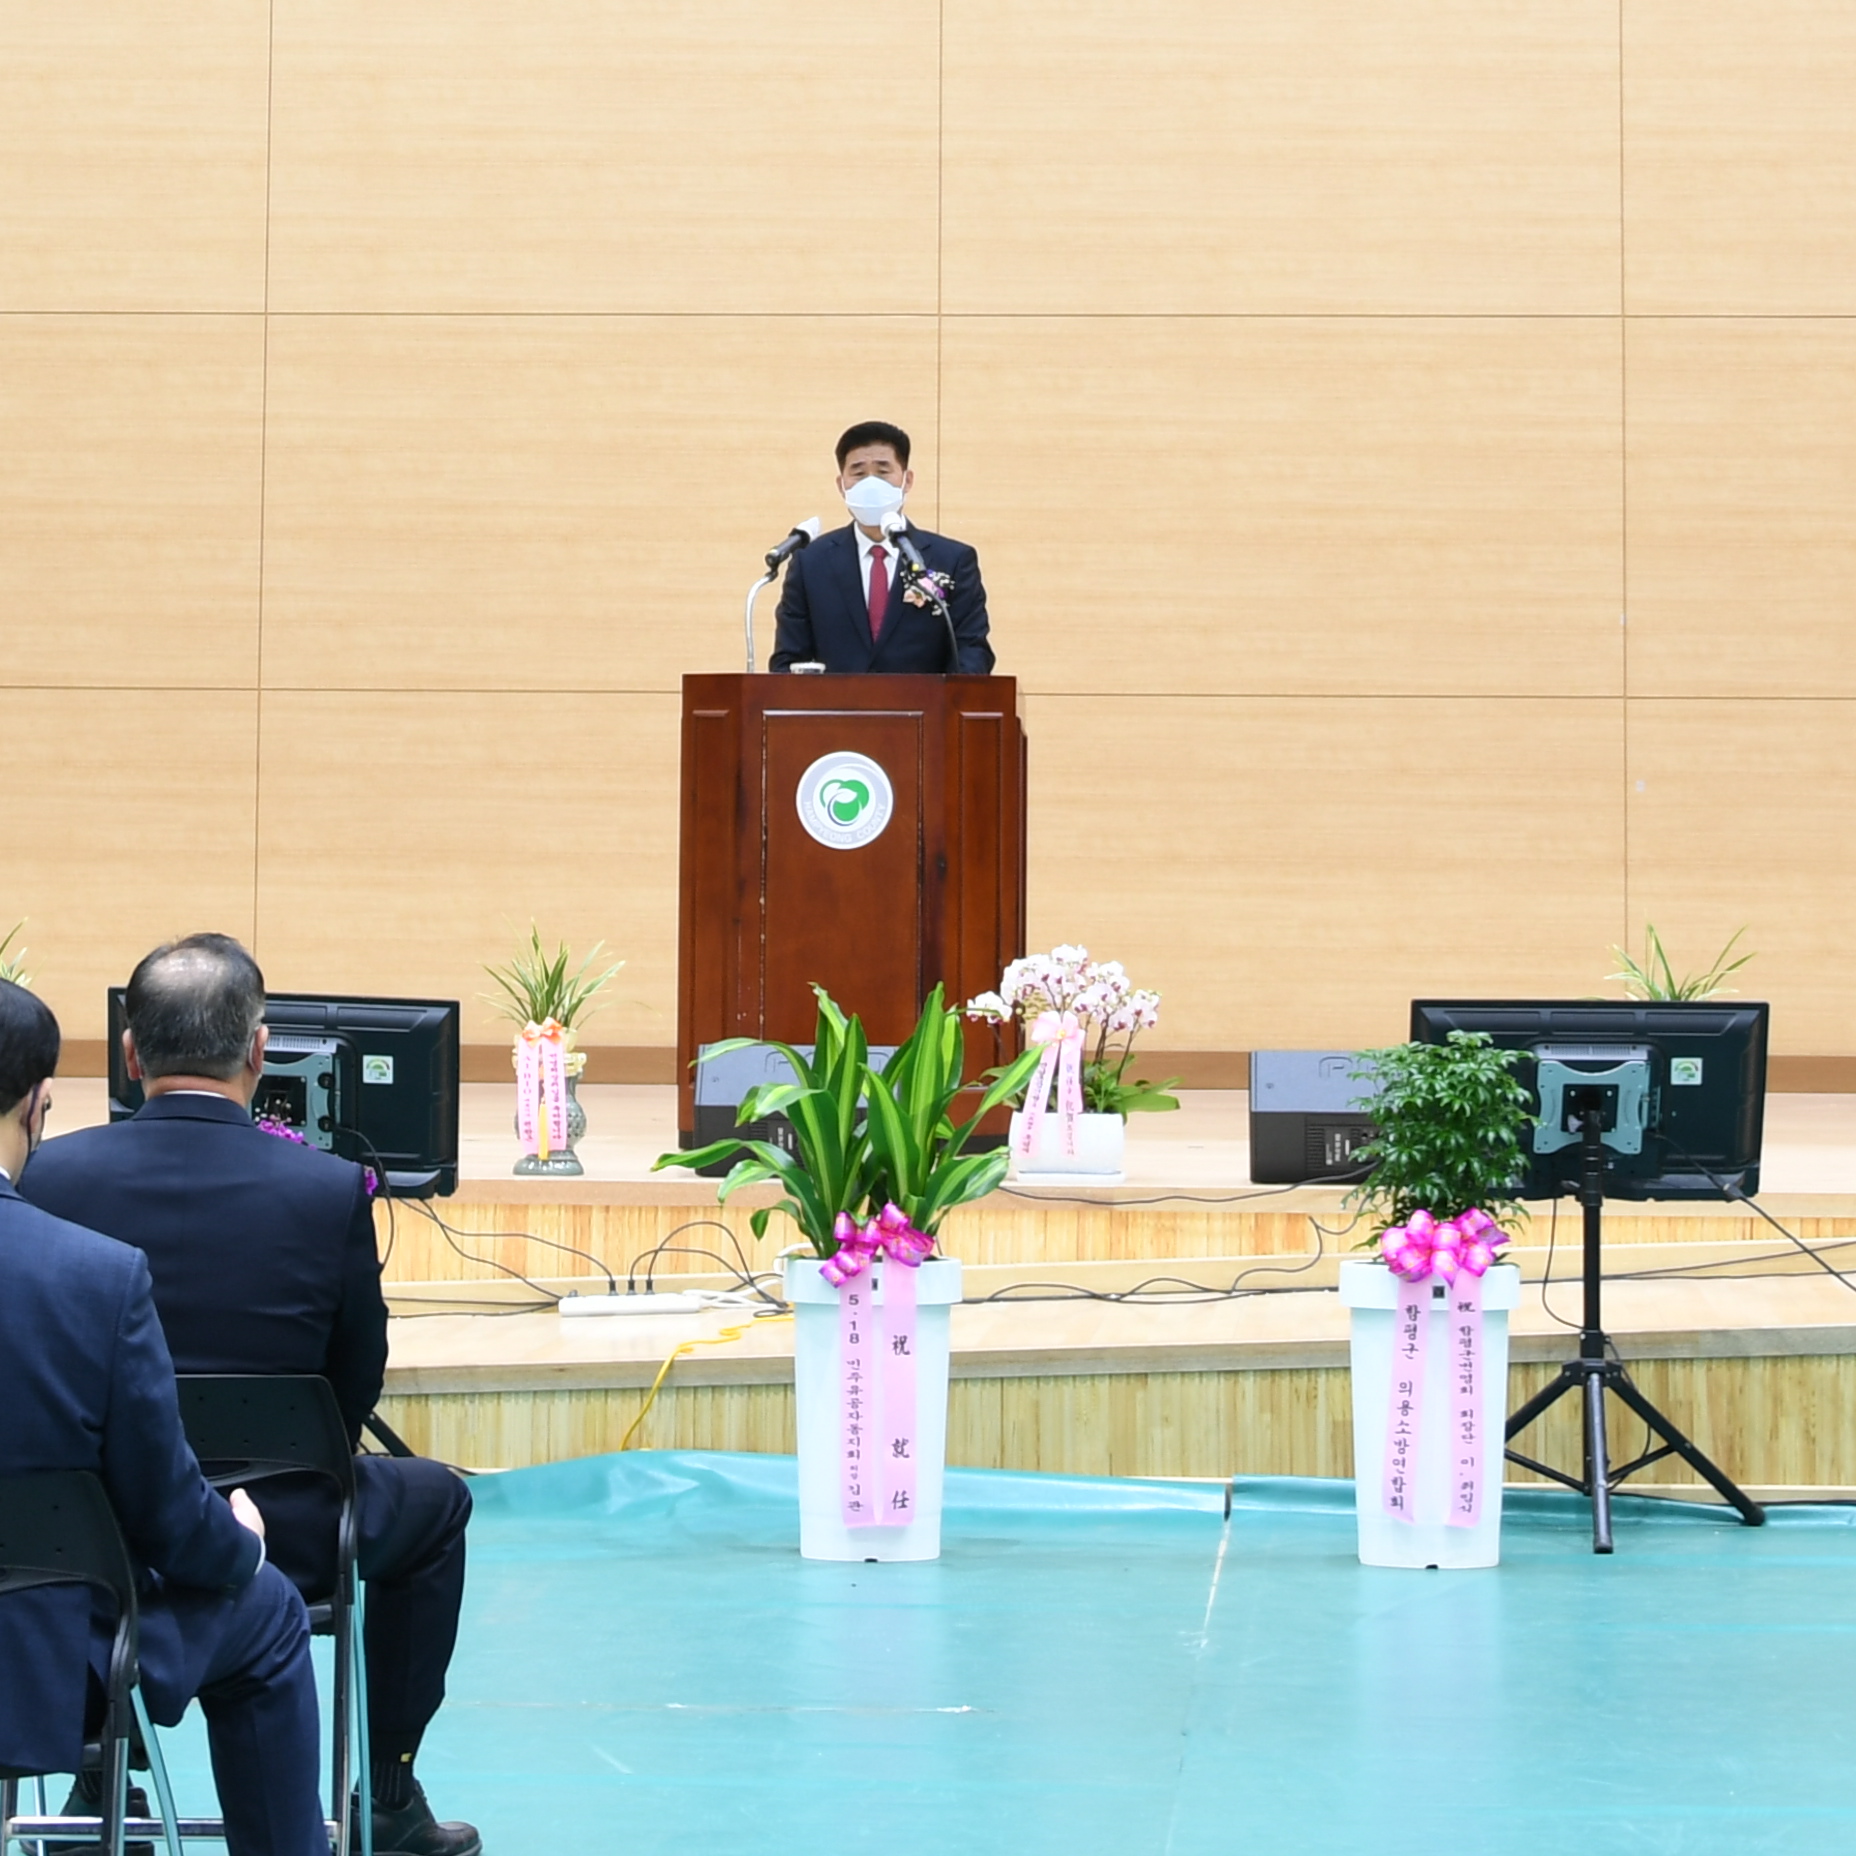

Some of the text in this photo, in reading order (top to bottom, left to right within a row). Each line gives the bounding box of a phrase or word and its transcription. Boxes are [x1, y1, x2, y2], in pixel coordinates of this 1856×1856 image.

[892, 1335, 911, 1356] 祝
[1458, 1325, 1476, 1396] 함평군번영회
[1390, 1304, 1421, 1511] 함평군 의용소방연합회
